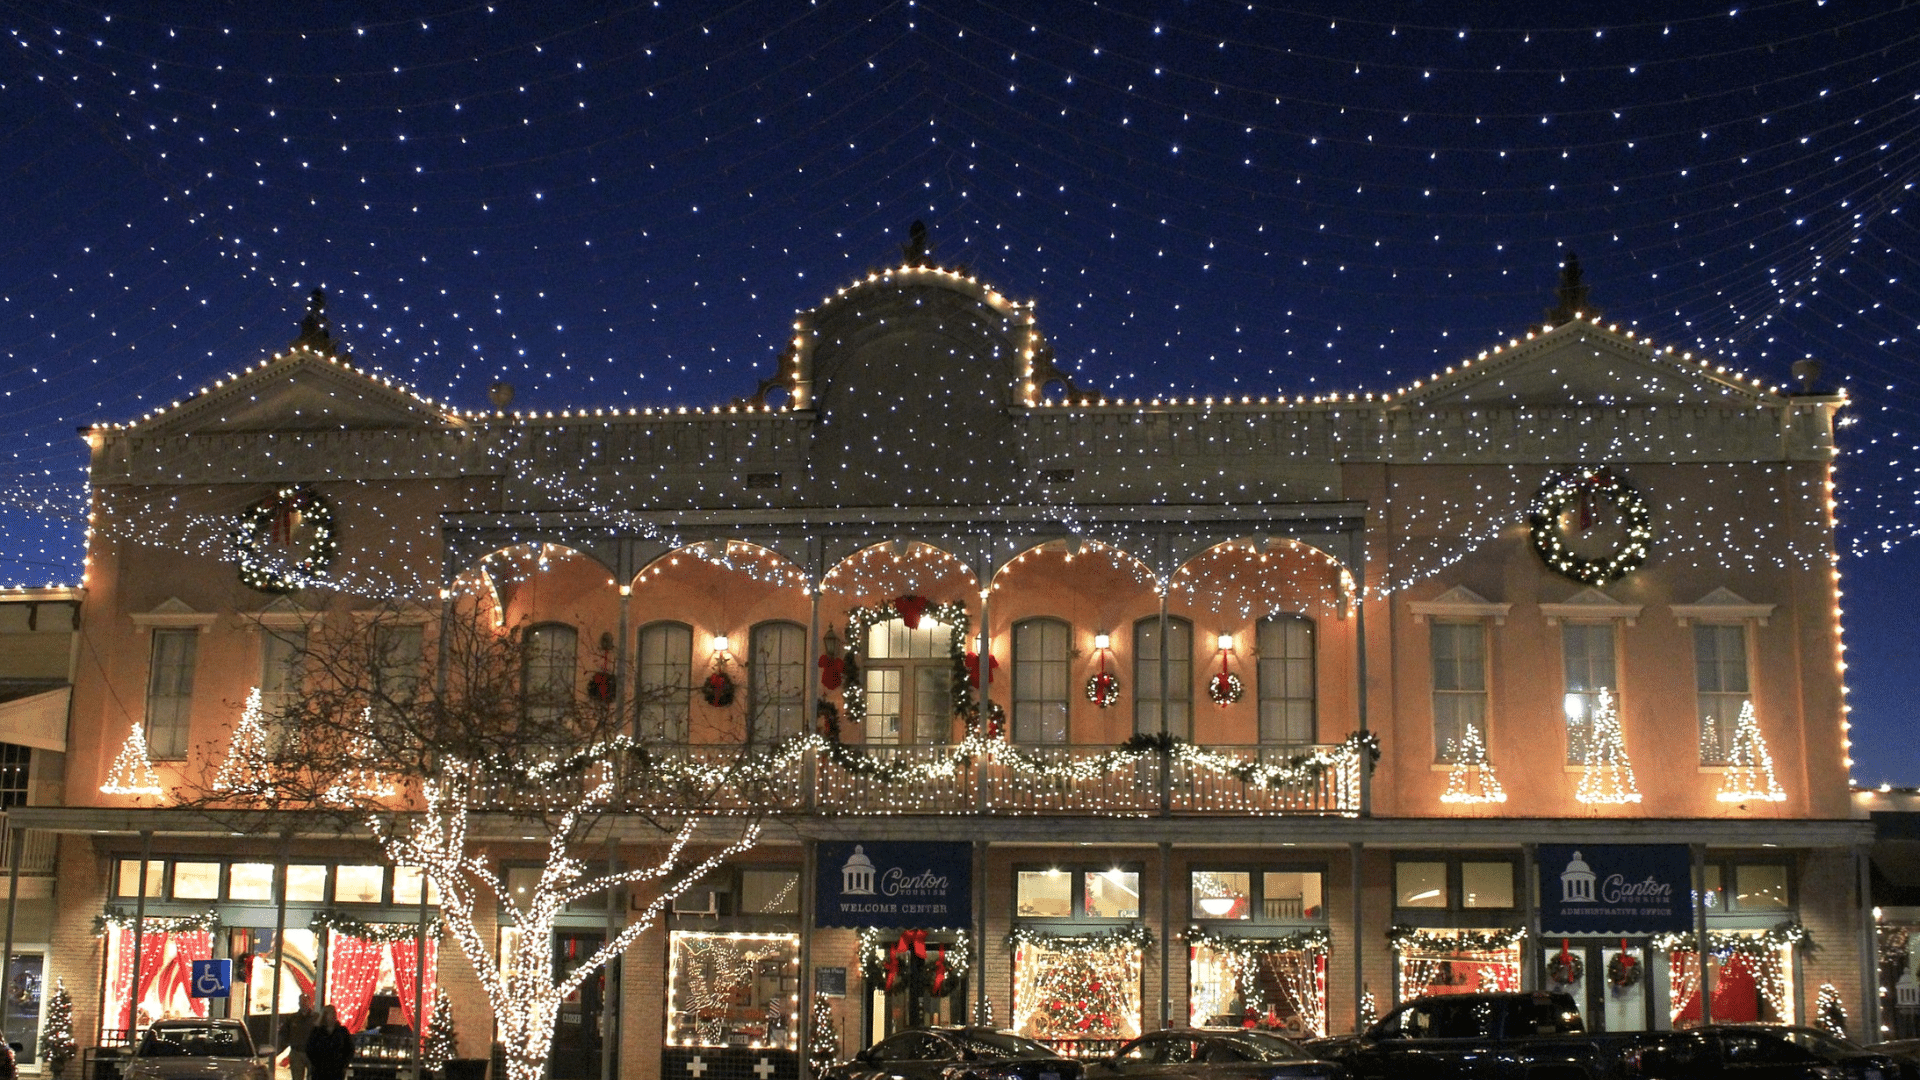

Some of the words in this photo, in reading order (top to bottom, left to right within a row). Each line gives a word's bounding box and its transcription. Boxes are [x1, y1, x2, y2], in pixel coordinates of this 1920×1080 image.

[881, 867, 949, 896] Canton
[1602, 874, 1672, 904] Canton
[840, 903, 897, 913] WELCOME
[901, 904, 948, 914] CENTER
[1560, 908, 1638, 916] ADMINISTRATIVE
[1640, 908, 1672, 916] OFFICE
